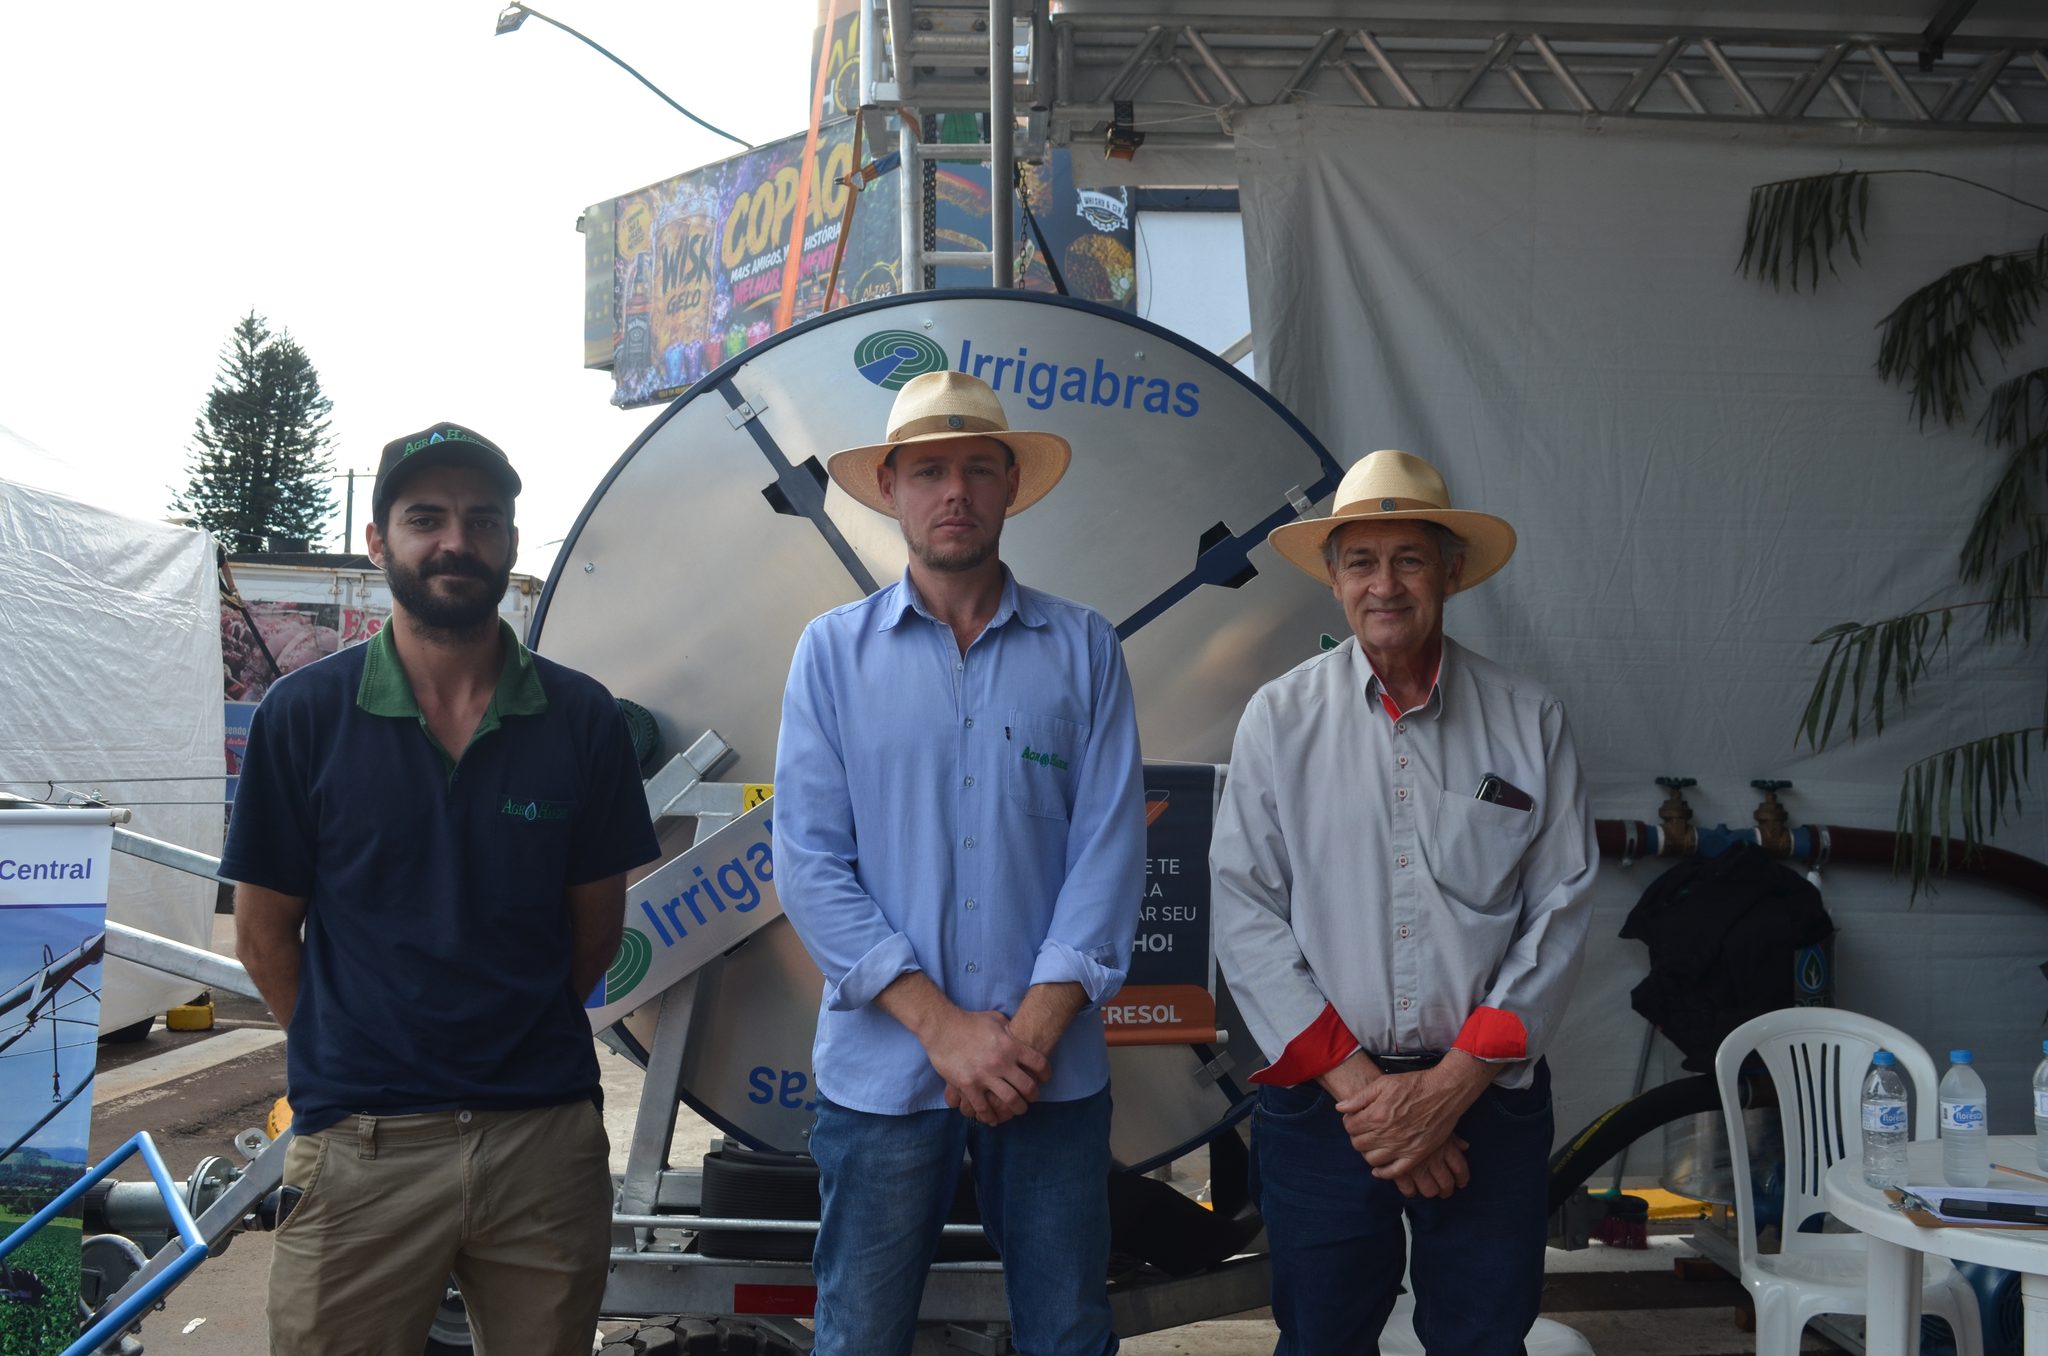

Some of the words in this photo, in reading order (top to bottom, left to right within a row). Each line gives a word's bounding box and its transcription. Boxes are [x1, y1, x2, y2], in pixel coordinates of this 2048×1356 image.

[731, 263, 751, 284] MAIS
[667, 288, 701, 315] GELO
[958, 340, 1200, 417] Irrigabras
[0, 858, 92, 880] Central
[1157, 858, 1180, 875] TE
[1150, 883, 1163, 897] A
[1162, 906, 1196, 921] SEU
